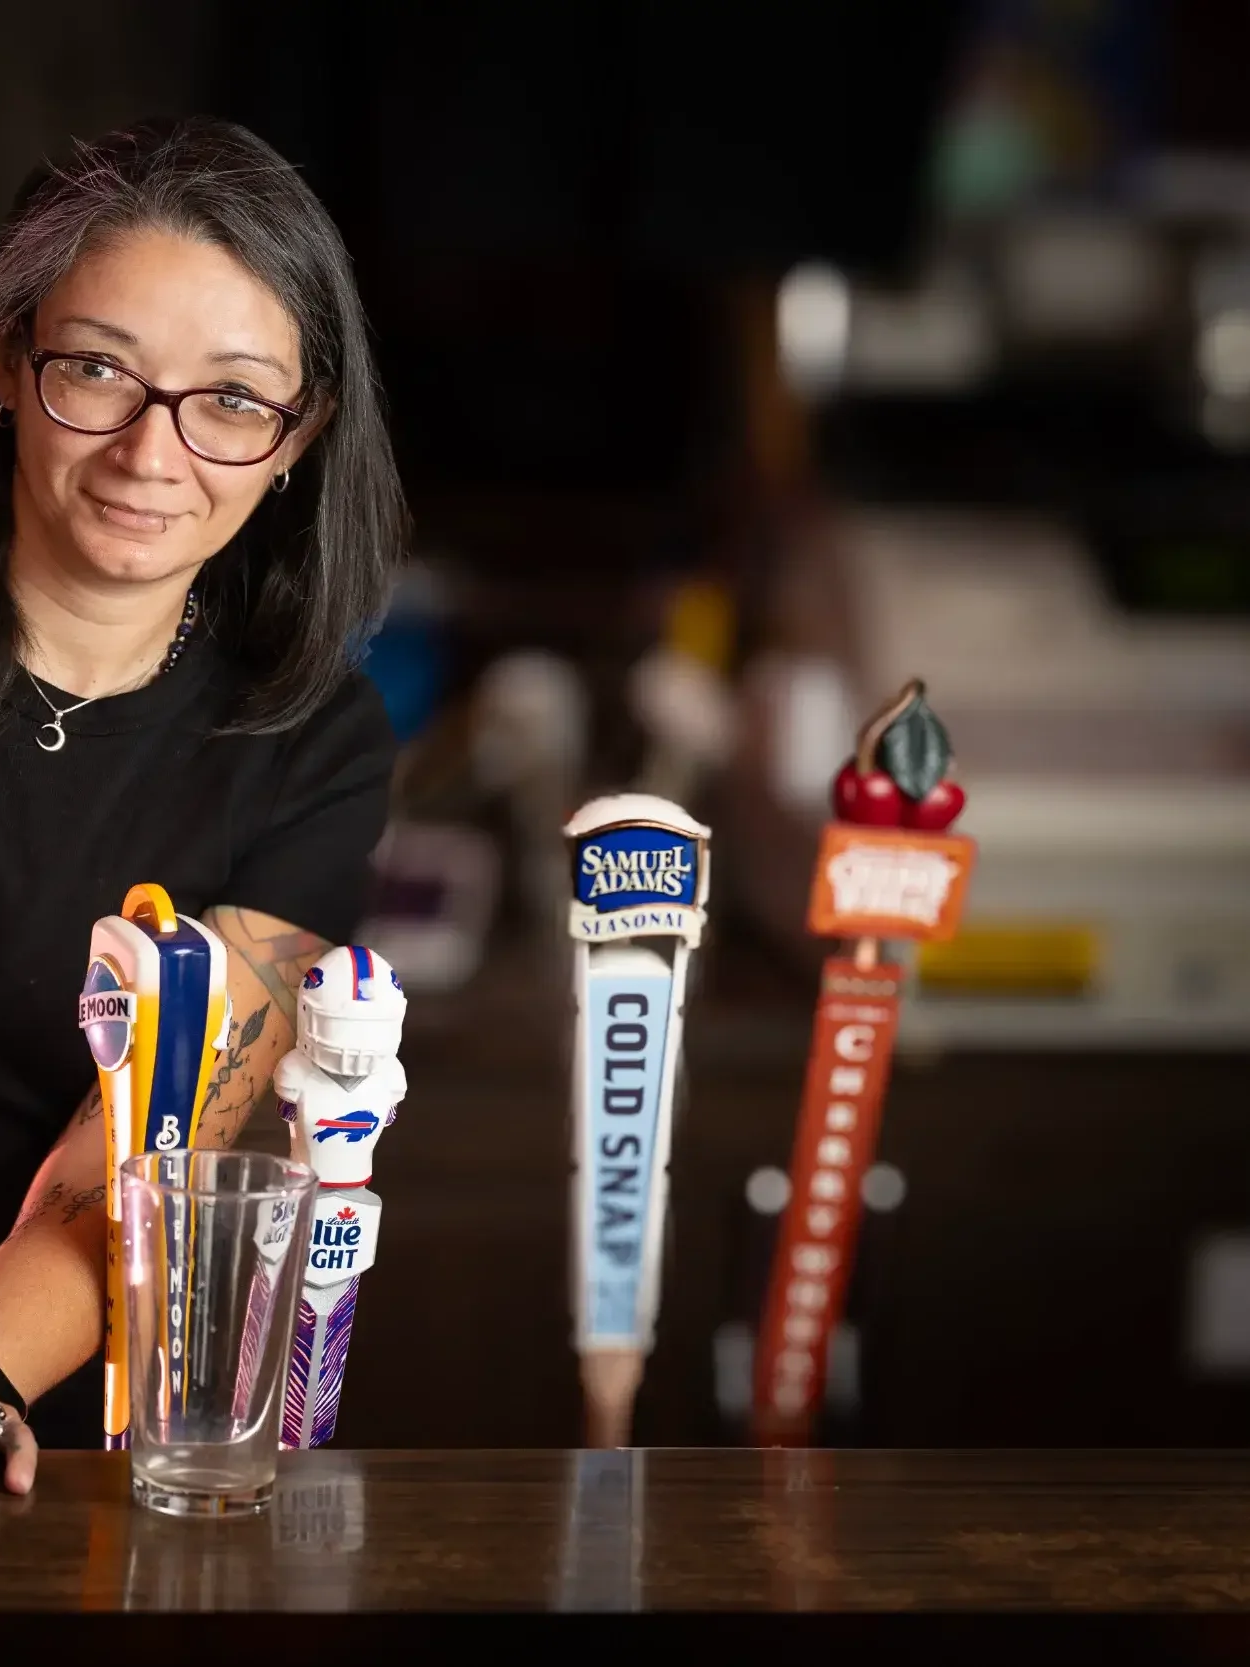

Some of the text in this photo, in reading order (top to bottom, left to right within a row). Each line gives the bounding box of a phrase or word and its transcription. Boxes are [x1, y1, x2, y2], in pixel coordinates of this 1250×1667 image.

[581, 845, 692, 875] SAMUEL
[588, 871, 684, 899] ADAMS
[597, 992, 650, 1269] COLD SNAP
[310, 1219, 362, 1246] lue
